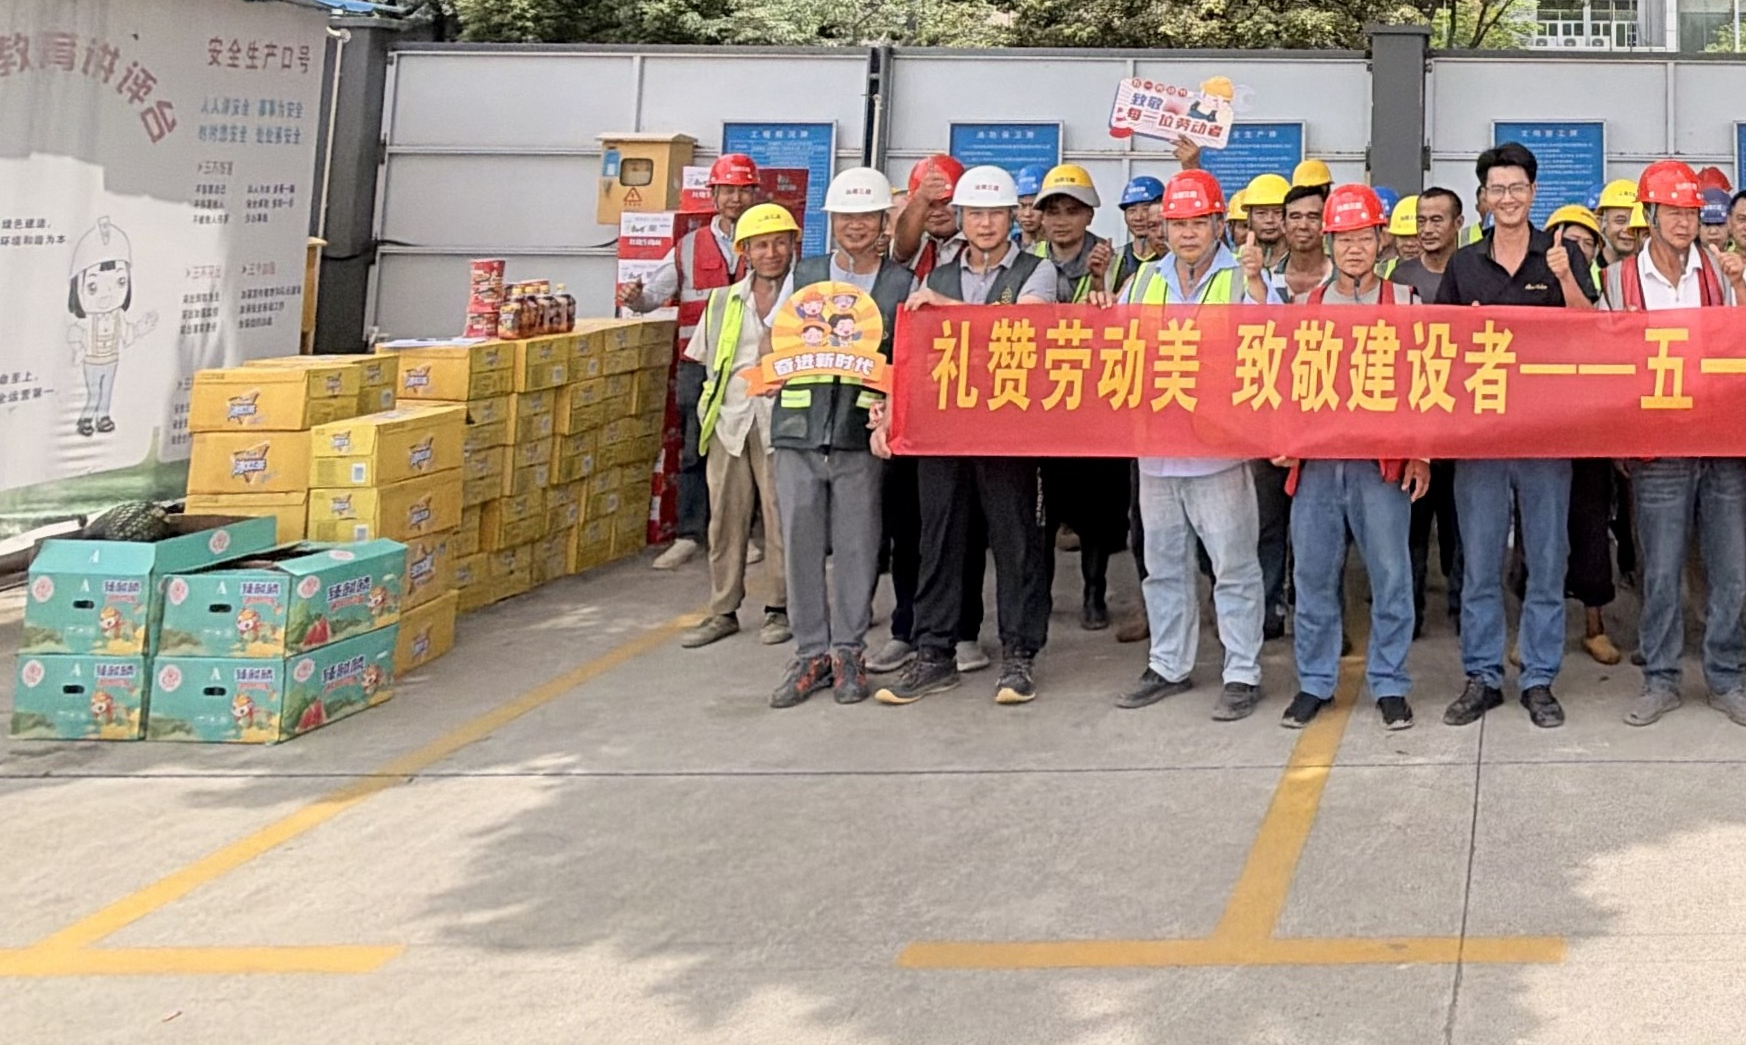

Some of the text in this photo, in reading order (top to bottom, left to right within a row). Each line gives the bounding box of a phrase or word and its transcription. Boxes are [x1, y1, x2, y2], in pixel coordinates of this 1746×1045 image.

[207, 36, 311, 75] 安全生产口号
[1130, 93, 1163, 110] 致敬
[1128, 108, 1223, 138] 每一位劳动者
[773, 353, 875, 375] 奋进新时代
[932, 318, 1201, 412] 礼赞劳动美
[80, 579, 90, 592] A
[216, 581, 227, 595] A
[71, 663, 81, 676] A
[210, 667, 221, 681] A
